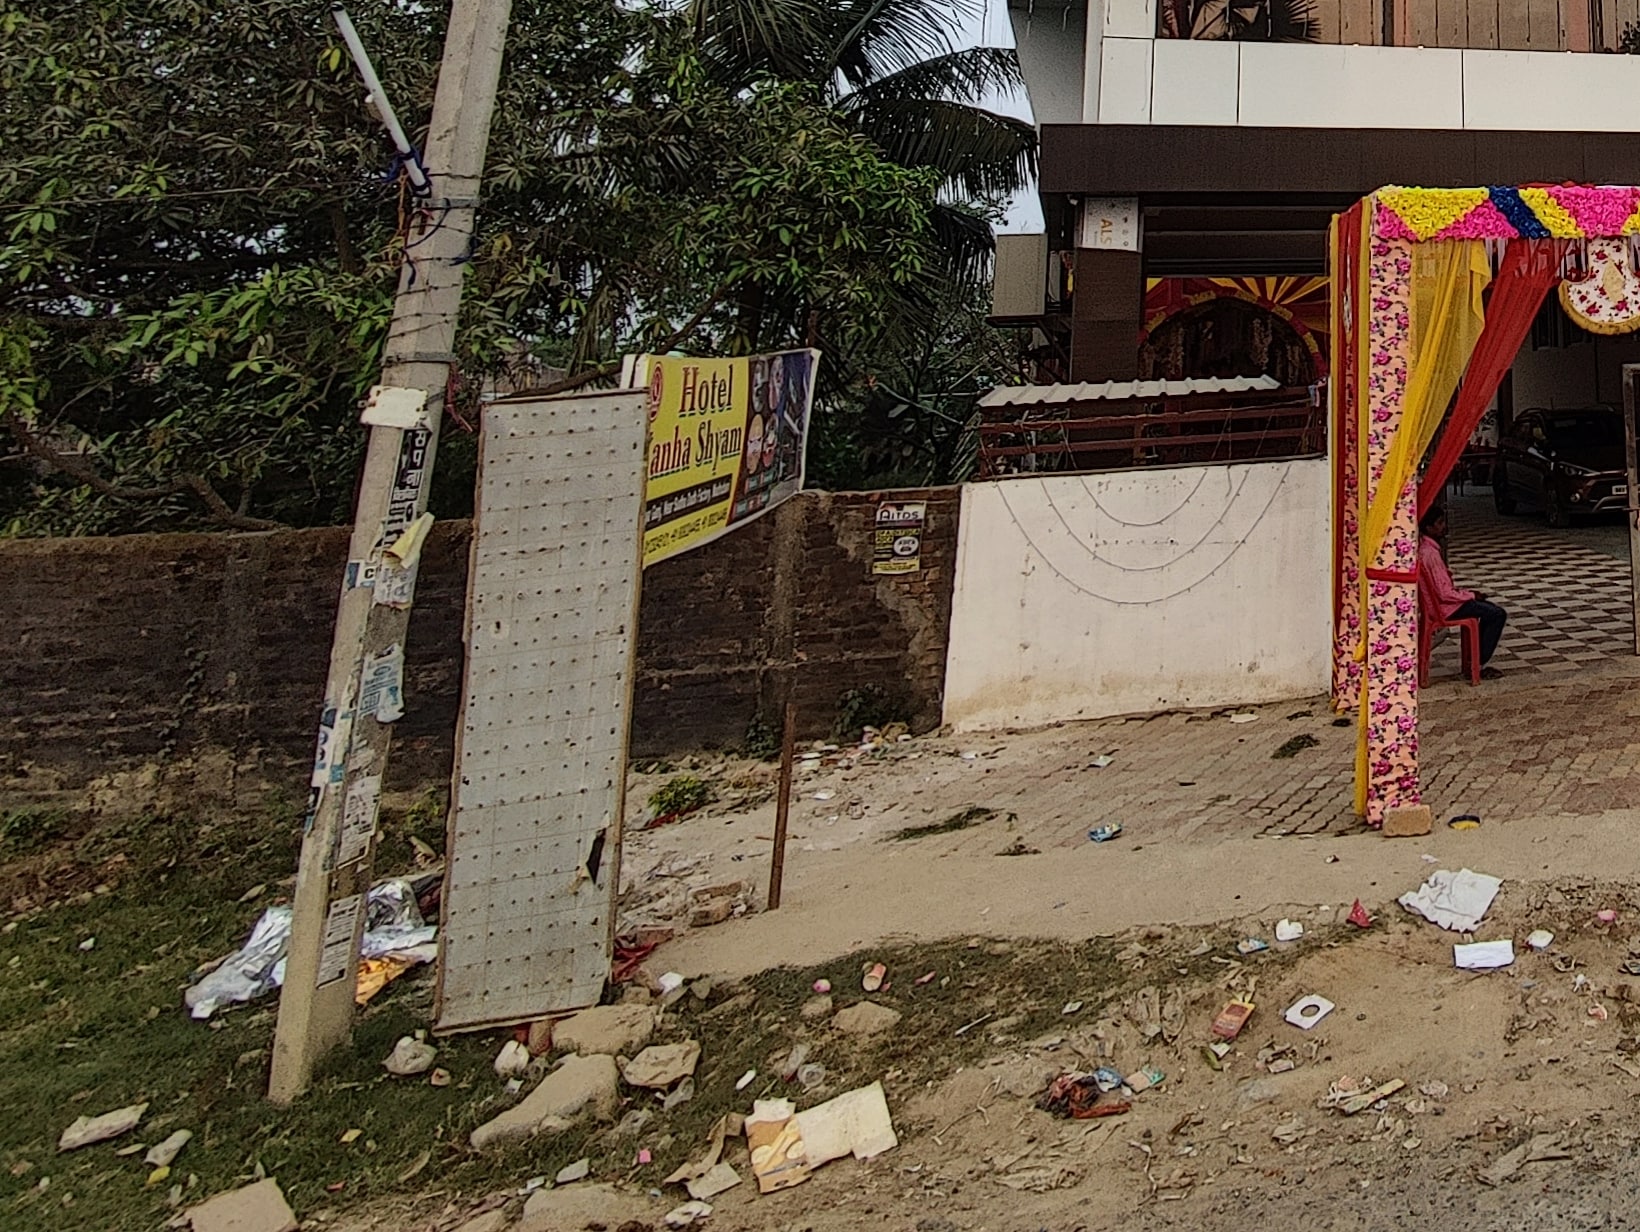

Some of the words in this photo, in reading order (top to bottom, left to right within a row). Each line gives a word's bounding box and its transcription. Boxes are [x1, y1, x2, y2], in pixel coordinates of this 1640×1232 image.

[678, 364, 733, 415] Hotel
[648, 425, 691, 477] anha
[695, 419, 742, 472] Shyam
